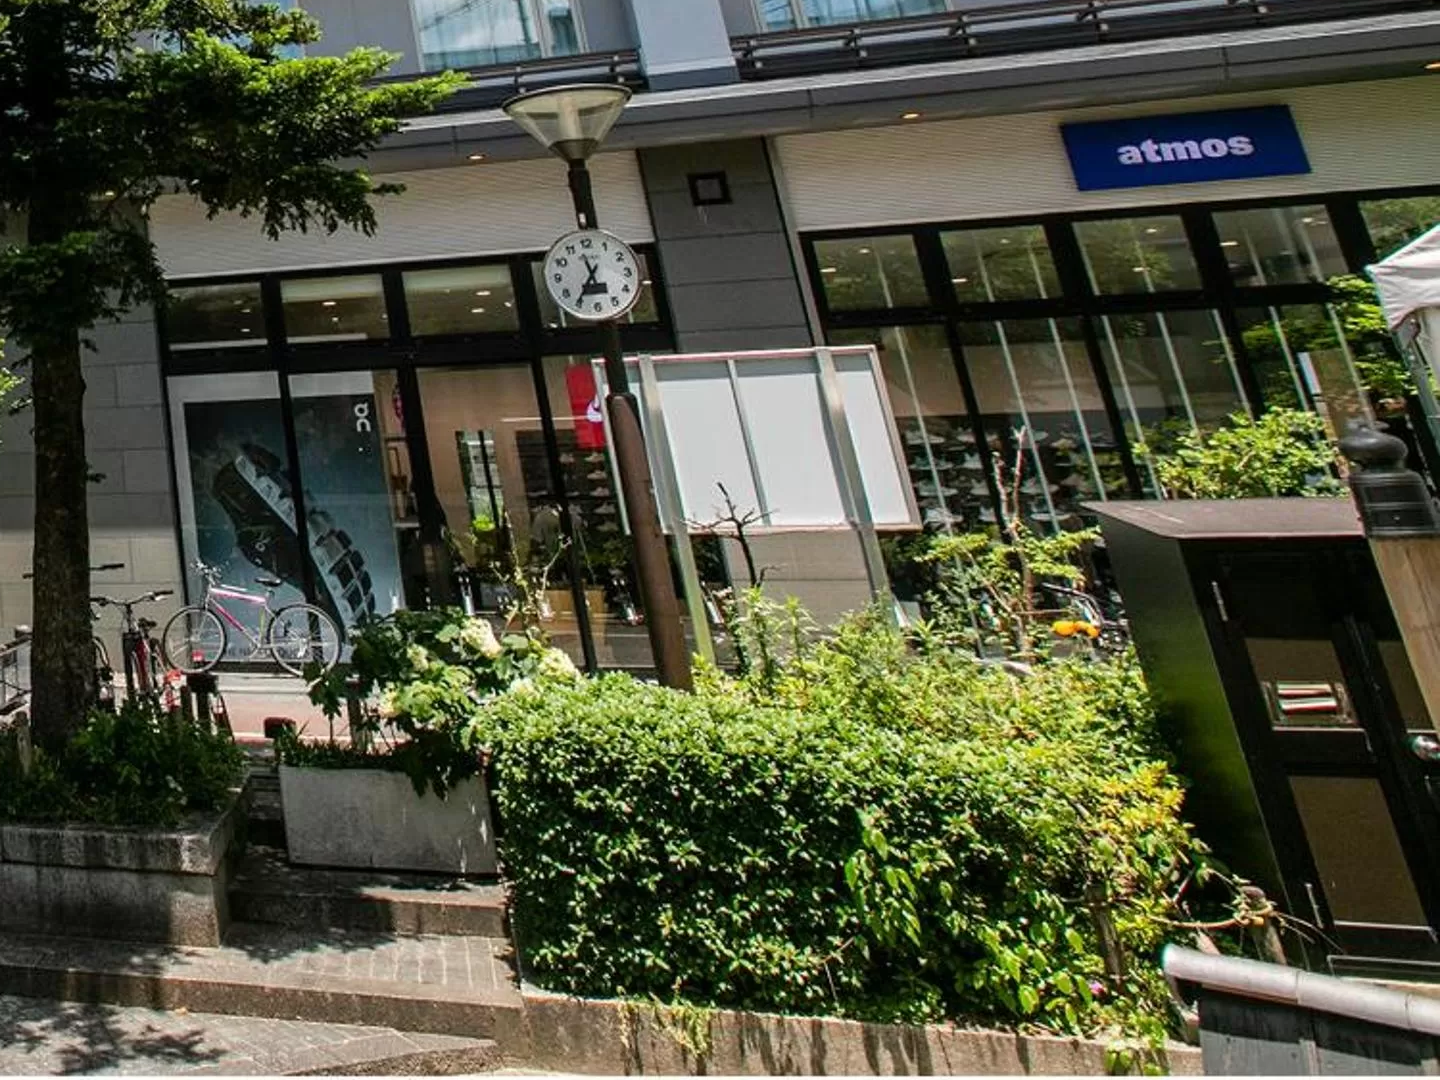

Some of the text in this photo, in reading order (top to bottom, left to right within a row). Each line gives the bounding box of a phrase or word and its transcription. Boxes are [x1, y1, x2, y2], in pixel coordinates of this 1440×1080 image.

[1117, 136, 1254, 165] atmos
[580, 239, 592, 249] 12
[624, 267, 632, 278] 3
